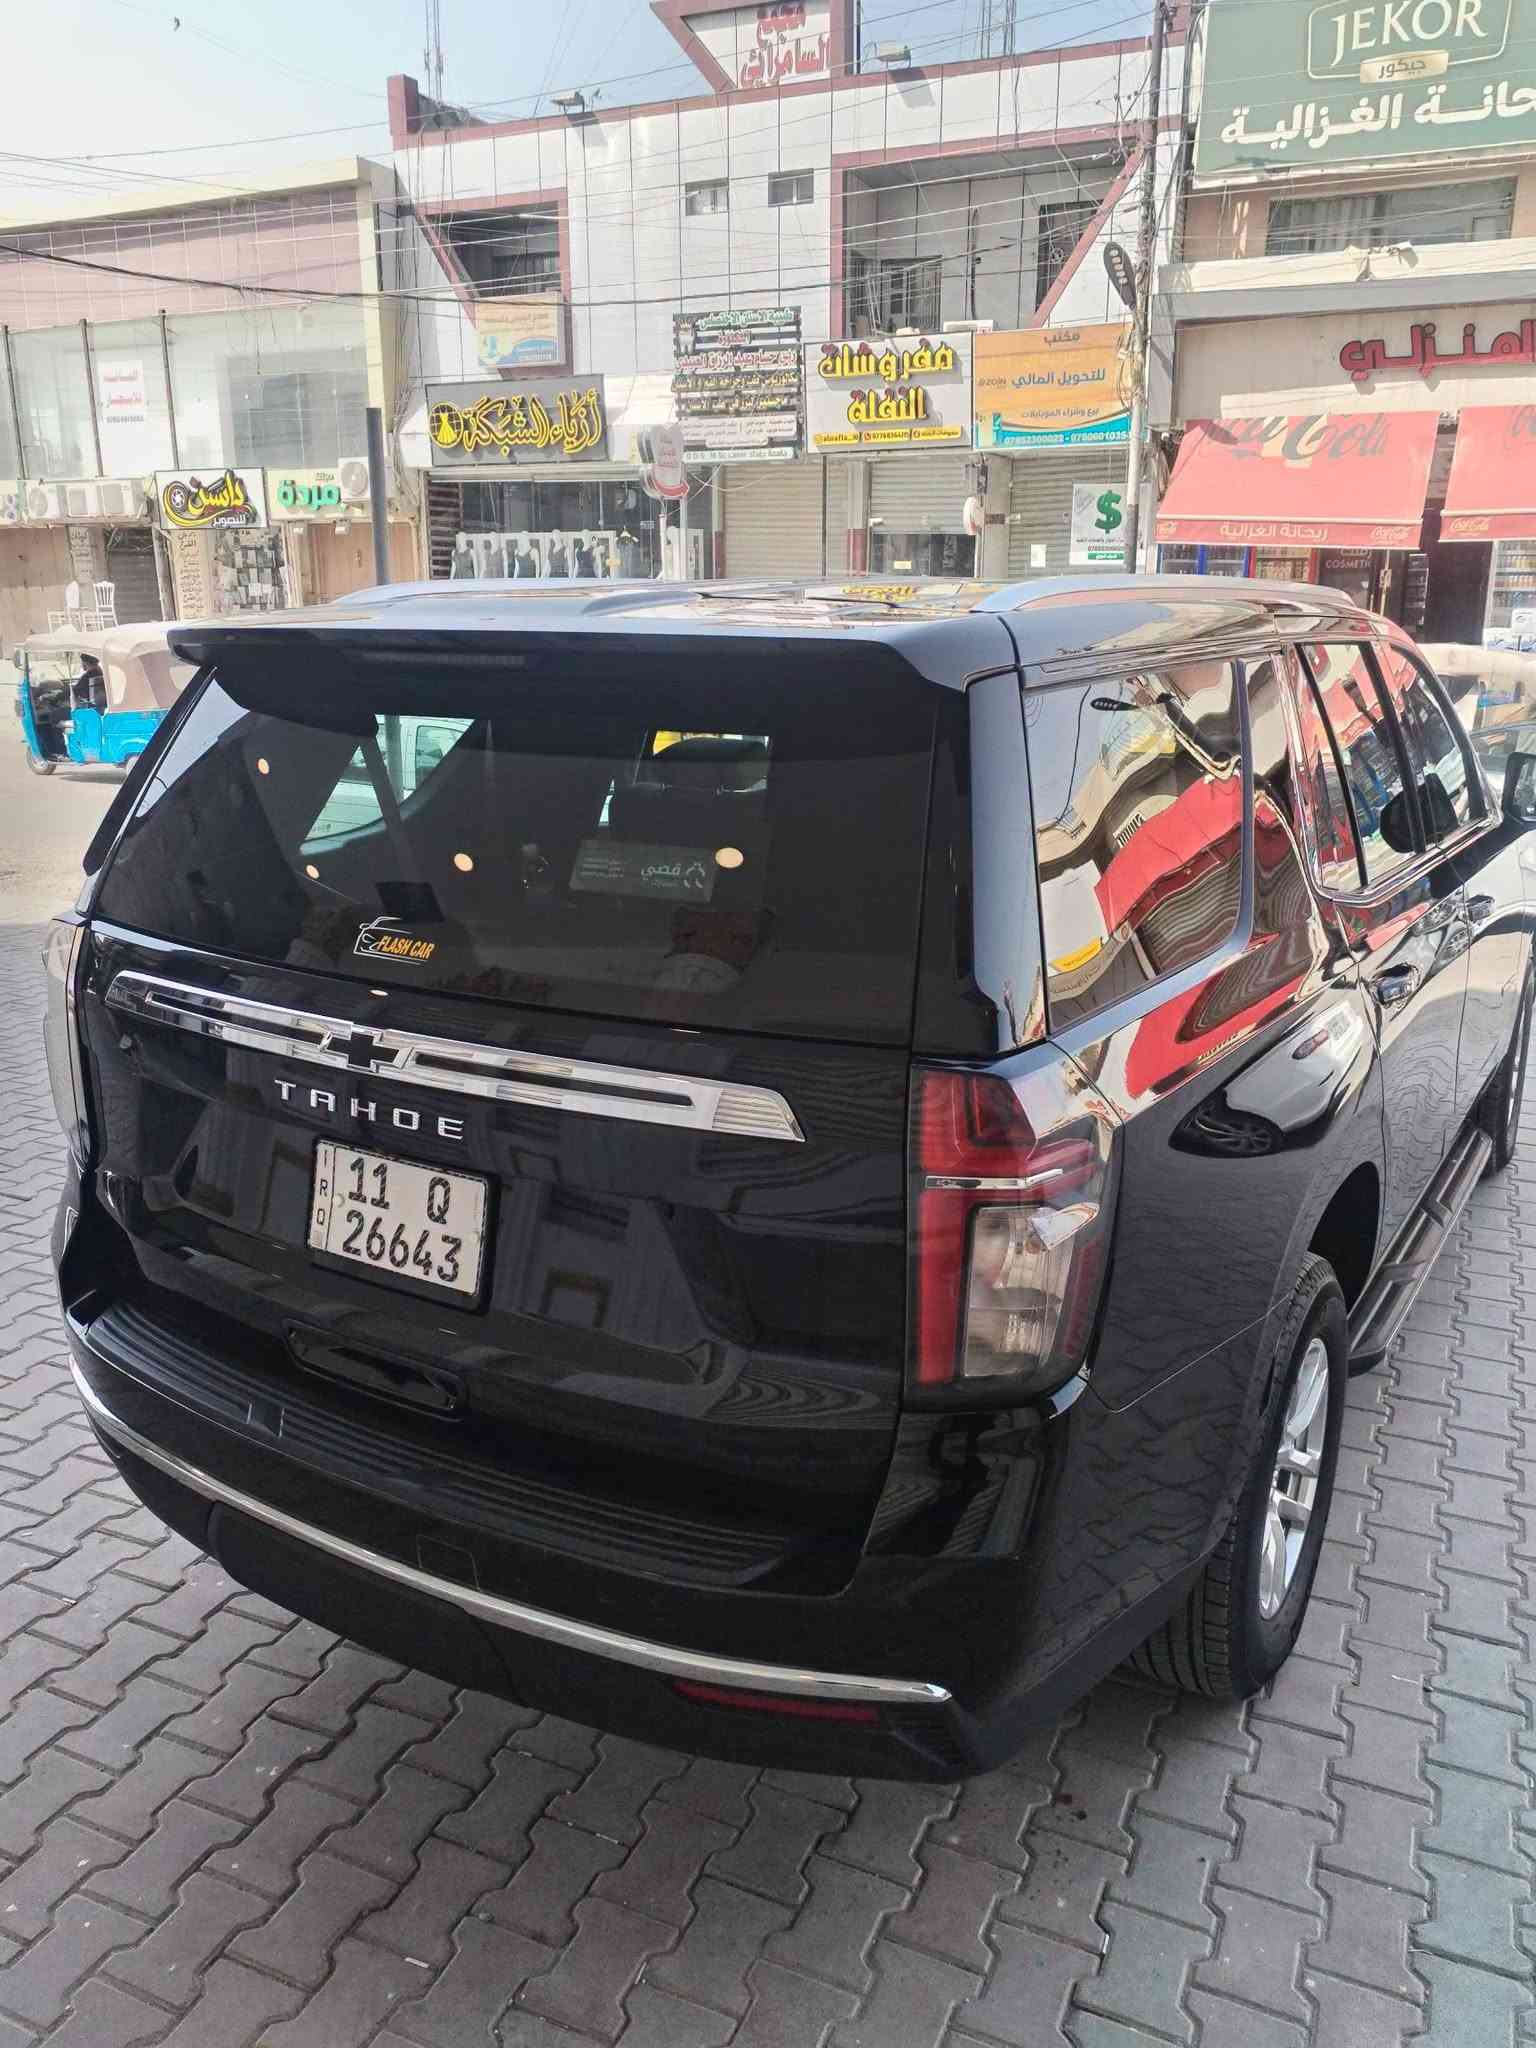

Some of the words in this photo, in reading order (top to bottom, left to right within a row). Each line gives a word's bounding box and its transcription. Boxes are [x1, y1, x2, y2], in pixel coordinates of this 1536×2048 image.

[1329, 0, 1488, 67] JEKOR
[1376, 59, 1427, 80] جيكور
[1220, 92, 1404, 150] الغزالية
[817, 337, 954, 382] مفروشات
[1043, 331, 1081, 346] مكتب
[1011, 373, 1055, 389] المالي
[1057, 368, 1106, 386] للتحويل
[463, 394, 551, 457] الشبكة
[548, 388, 602, 454] أزياء
[377, 935, 411, 955] FLASH
[411, 940, 436, 960] CAR
[274, 1079, 465, 1140] TAHOE
[348, 1156, 390, 1210] 11
[426, 1176, 451, 1225] Q
[342, 1209, 462, 1283] 26643
